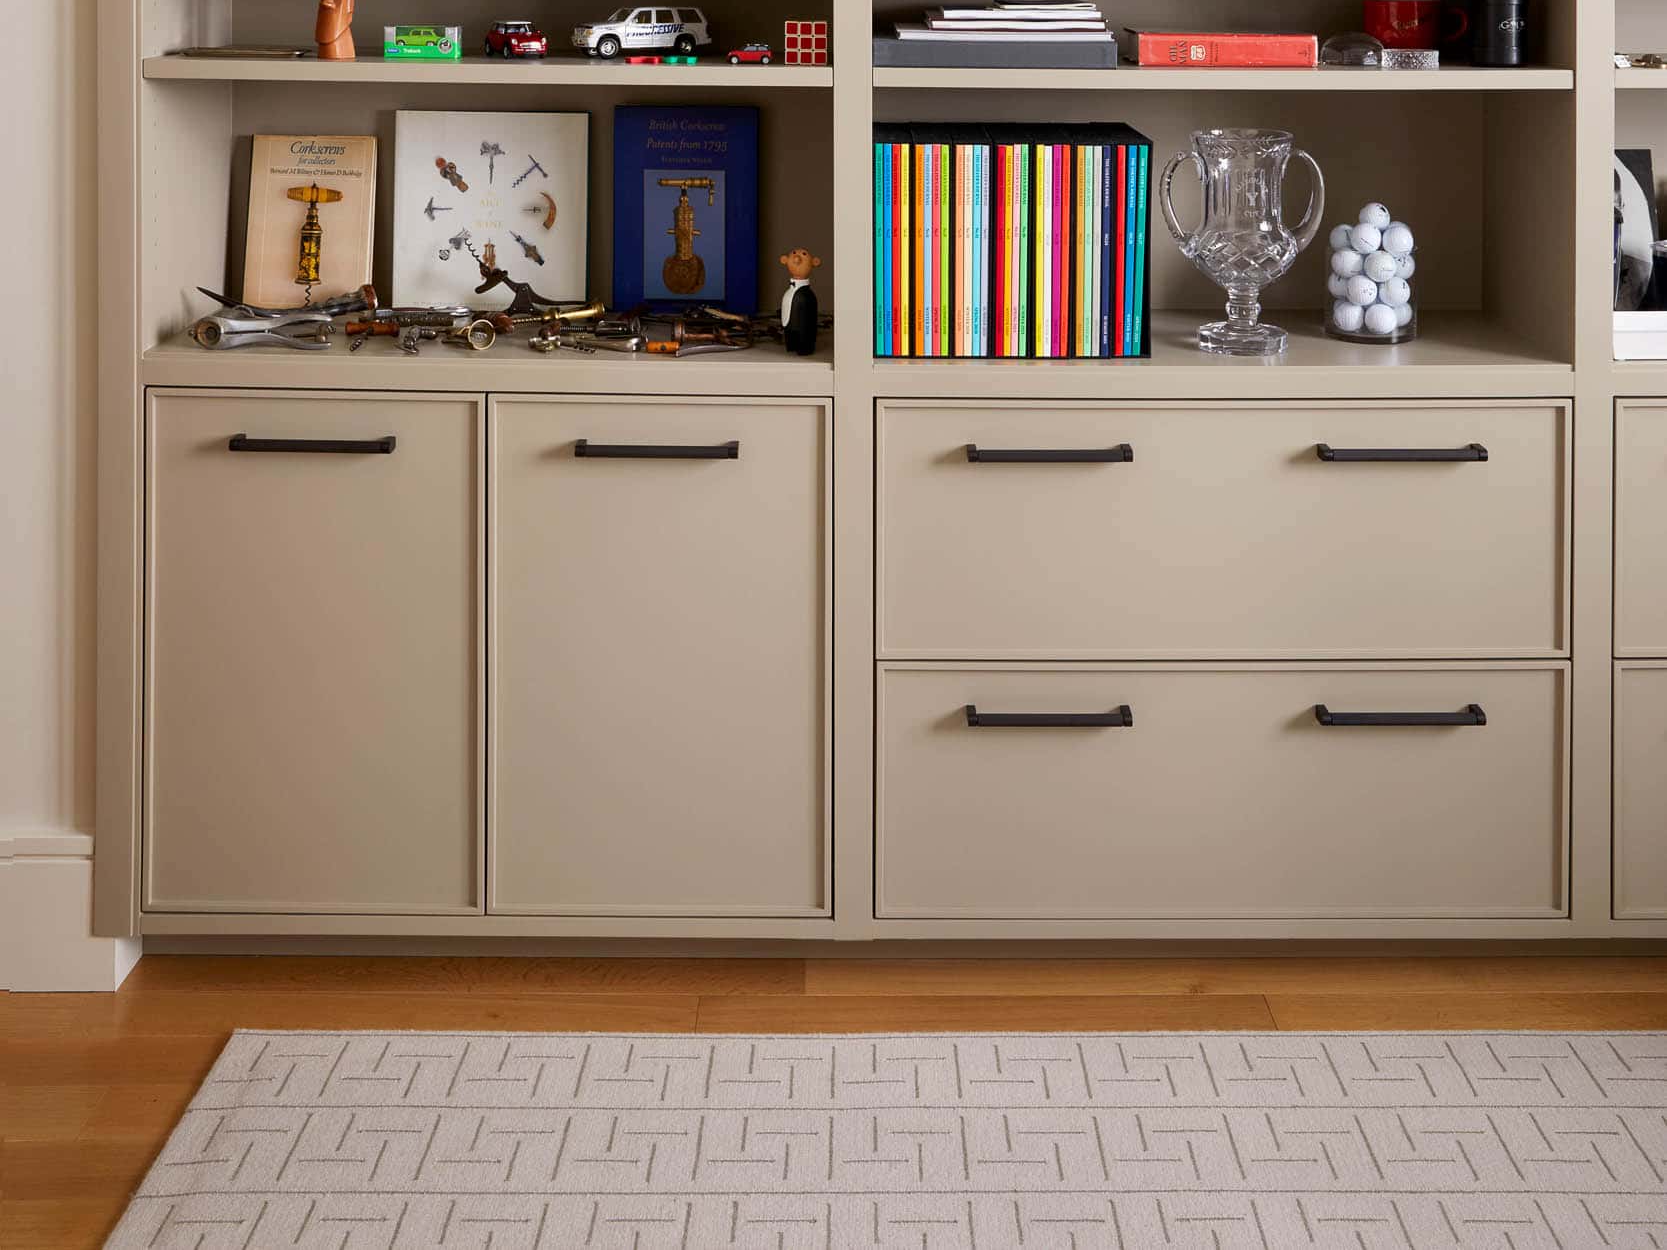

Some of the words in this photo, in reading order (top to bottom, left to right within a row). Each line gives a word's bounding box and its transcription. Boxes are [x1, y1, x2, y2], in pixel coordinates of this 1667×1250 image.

[1169, 45, 1178, 62] OIL
[1179, 40, 1188, 64] MAN
[649, 120, 677, 131] British
[290, 141, 346, 156] Corkscrews
[646, 137, 678, 150] Patents
[680, 139, 700, 151] from
[704, 140, 728, 153] 1795
[296, 157, 308, 167] for
[308, 157, 336, 166] collectors
